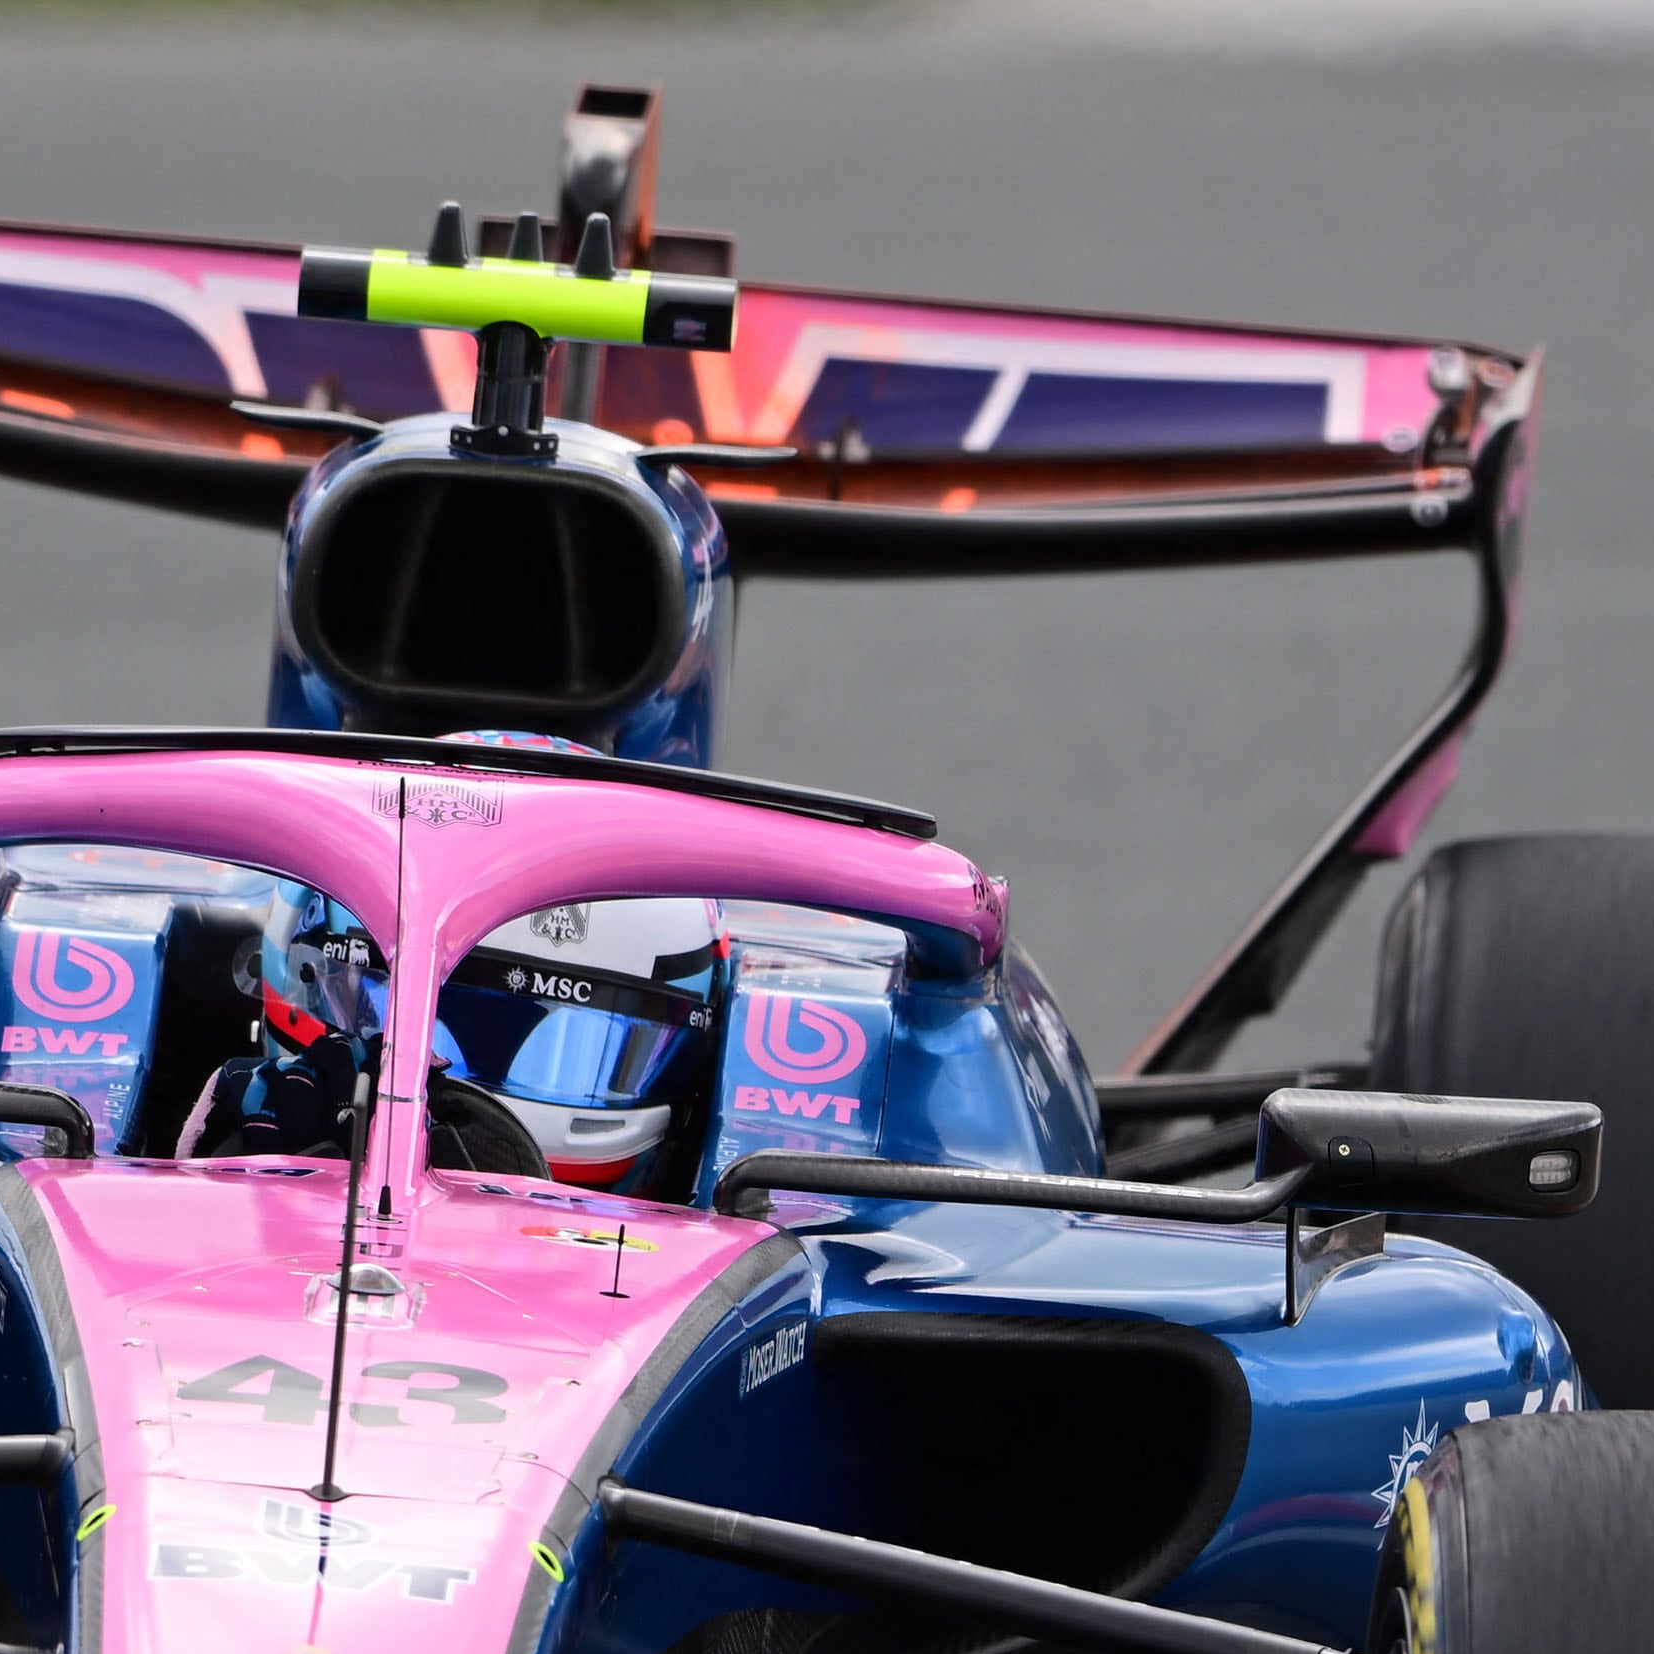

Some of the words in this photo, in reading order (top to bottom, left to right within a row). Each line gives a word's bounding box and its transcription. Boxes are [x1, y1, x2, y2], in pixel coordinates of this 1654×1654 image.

[323, 940, 349, 961] eni
[531, 972, 592, 1003] MSC
[1, 1026, 129, 1057] BWT
[103, 1083, 131, 1120] ALPINE
[734, 1085, 861, 1125] BWT
[177, 1354, 509, 1428] 43
[149, 1542, 475, 1603] BWT
